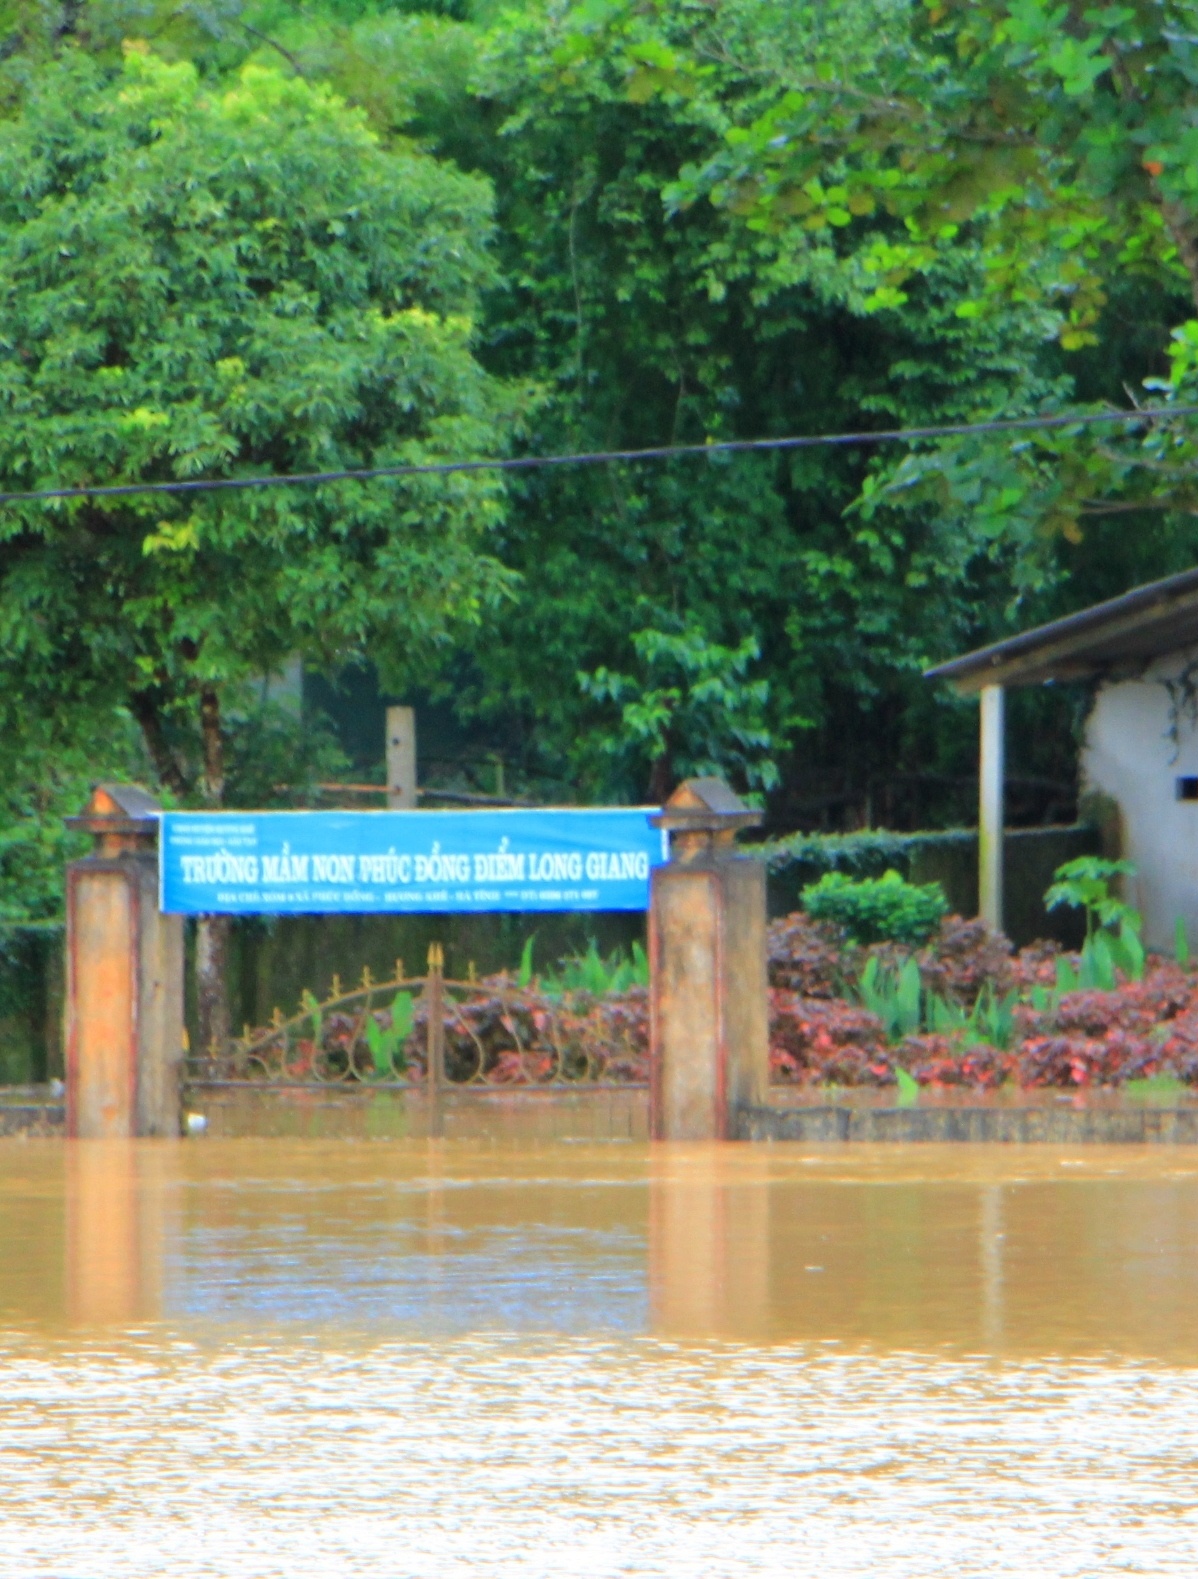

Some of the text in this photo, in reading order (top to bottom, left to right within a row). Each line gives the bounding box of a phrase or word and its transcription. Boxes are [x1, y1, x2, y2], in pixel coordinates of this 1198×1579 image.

[180, 847, 260, 884] TRƯỜNG
[311, 854, 356, 883] NON
[359, 845, 412, 884] PHÚC
[414, 840, 471, 883] ĐỒNG
[473, 835, 526, 882] ĐIỂM
[528, 852, 583, 882] LONG
[586, 851, 649, 881] GIANG
